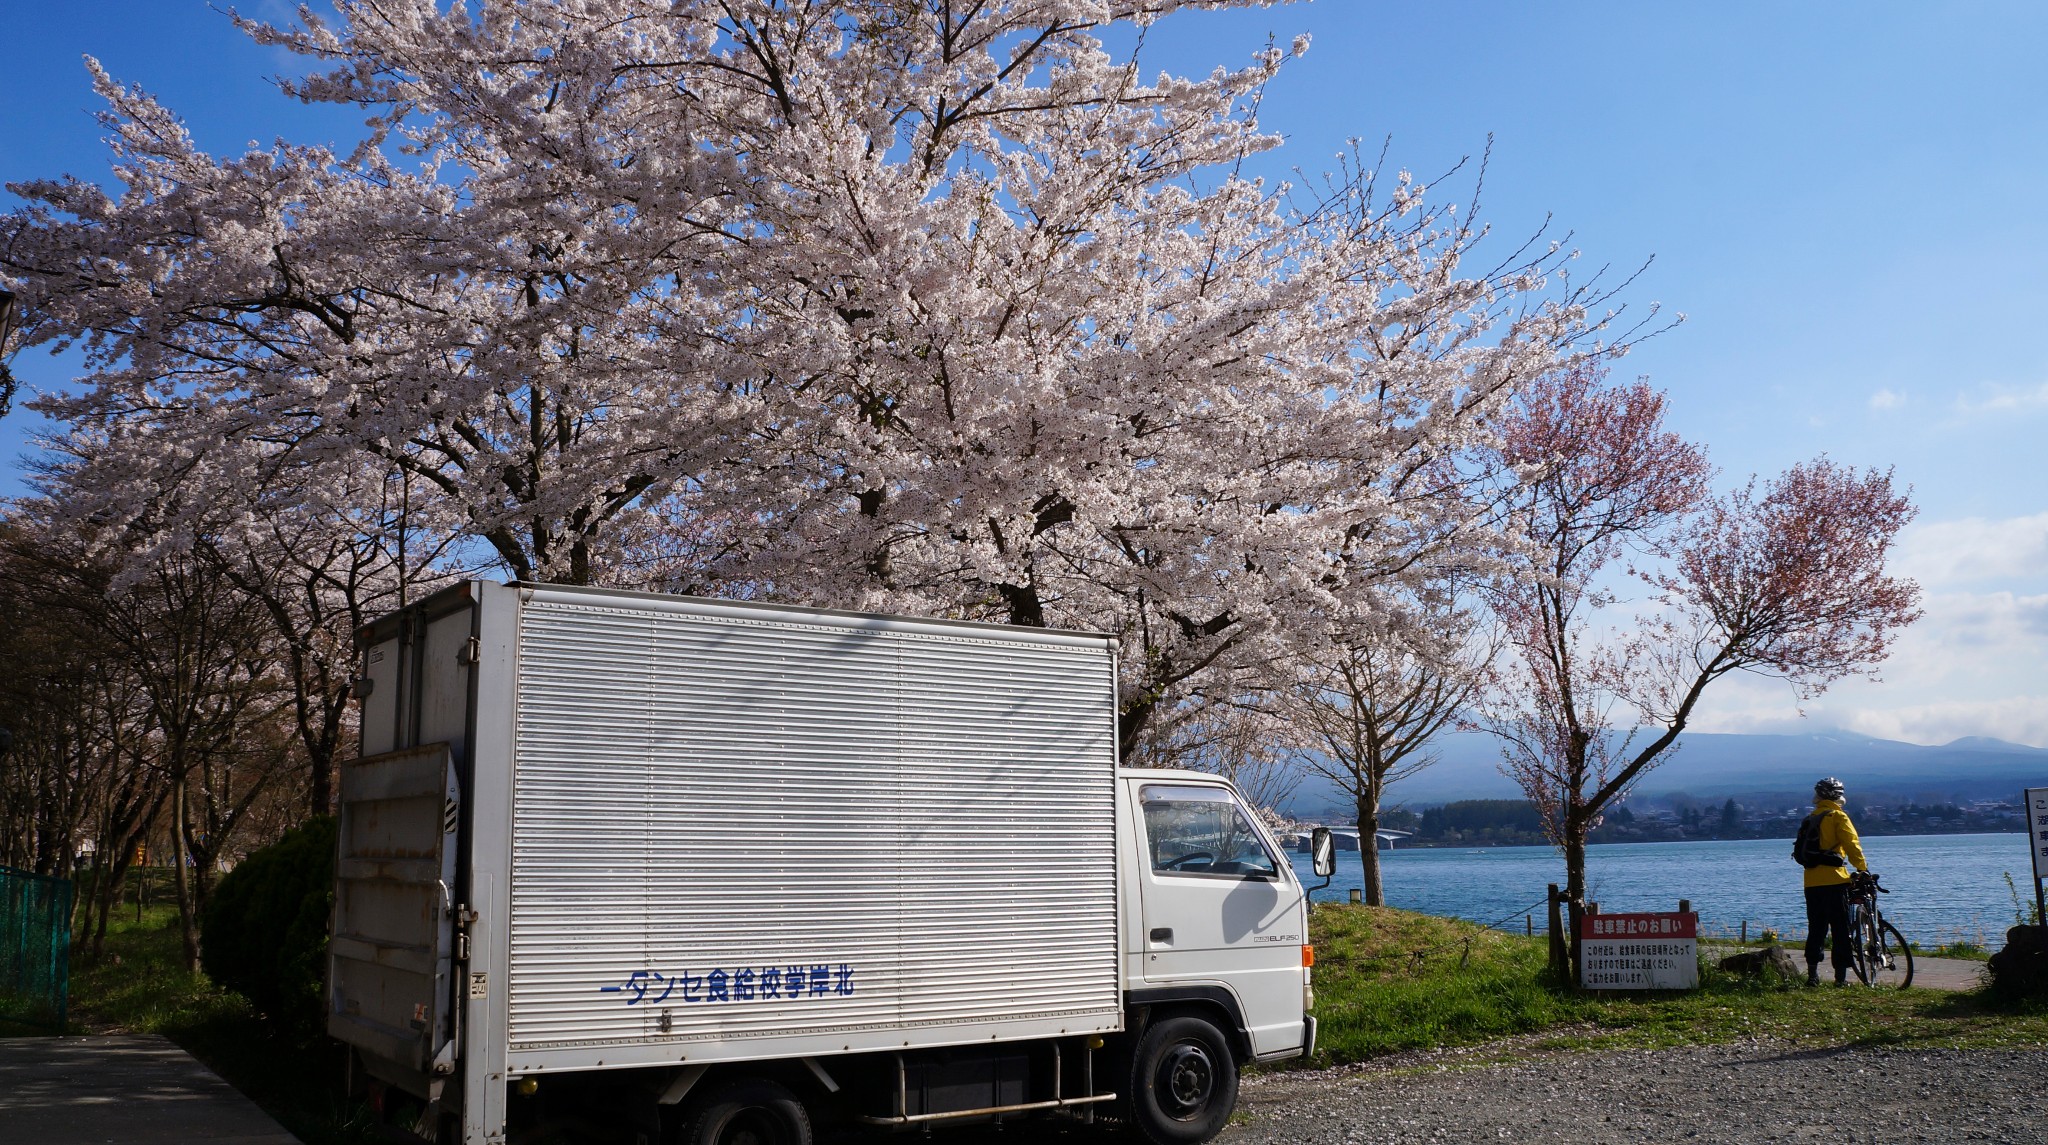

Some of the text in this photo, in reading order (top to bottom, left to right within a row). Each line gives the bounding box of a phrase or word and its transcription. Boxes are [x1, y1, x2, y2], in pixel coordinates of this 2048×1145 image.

[1593, 919, 1682, 934] 駐車禁止のお願い
